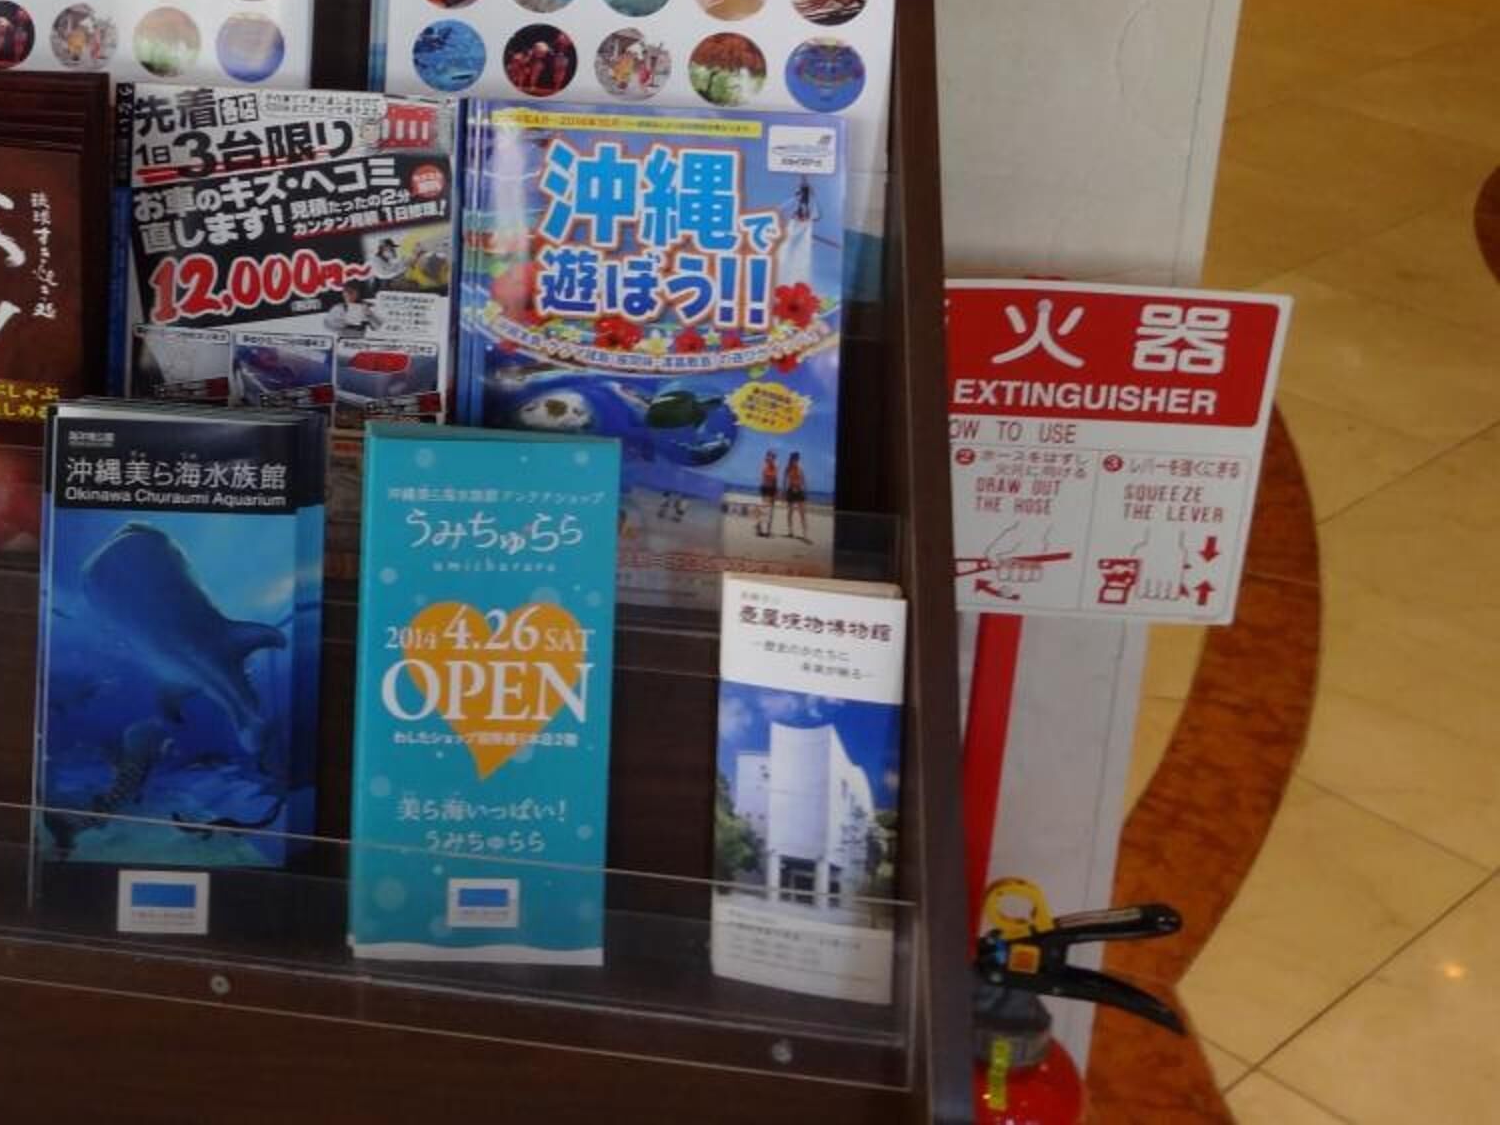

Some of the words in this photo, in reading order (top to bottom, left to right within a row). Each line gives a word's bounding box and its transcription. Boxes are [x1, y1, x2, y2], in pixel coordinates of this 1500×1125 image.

[540, 140, 780, 252] 沖縄で
[138, 203, 287, 254] 直します!
[537, 245, 773, 329] 遊ぼう!!
[945, 297, 1232, 376] 火器
[952, 378, 1218, 416] EXTINGUISHER
[948, 420, 980, 442] OW
[998, 421, 1022, 442] TO
[1038, 424, 1078, 444] USE
[65, 454, 287, 490] 沖縄美ら海水族館
[974, 477, 1021, 495] DRAW
[1031, 479, 1062, 497] OUT
[65, 486, 132, 503] Okinawa
[134, 487, 209, 505] Churaumi
[211, 491, 287, 508] Aquarium
[974, 496, 1003, 513] THE
[1013, 497, 1053, 515] HOSE
[1123, 484, 1205, 504] SQUEEZE
[404, 507, 584, 555] うみちゅらら
[1123, 503, 1155, 521] THE
[1165, 505, 1225, 524] LEVER
[385, 626, 438, 652] 2014
[442, 604, 541, 653] 4.26
[544, 628, 596, 653] SAT
[380, 659, 595, 724] OPEN
